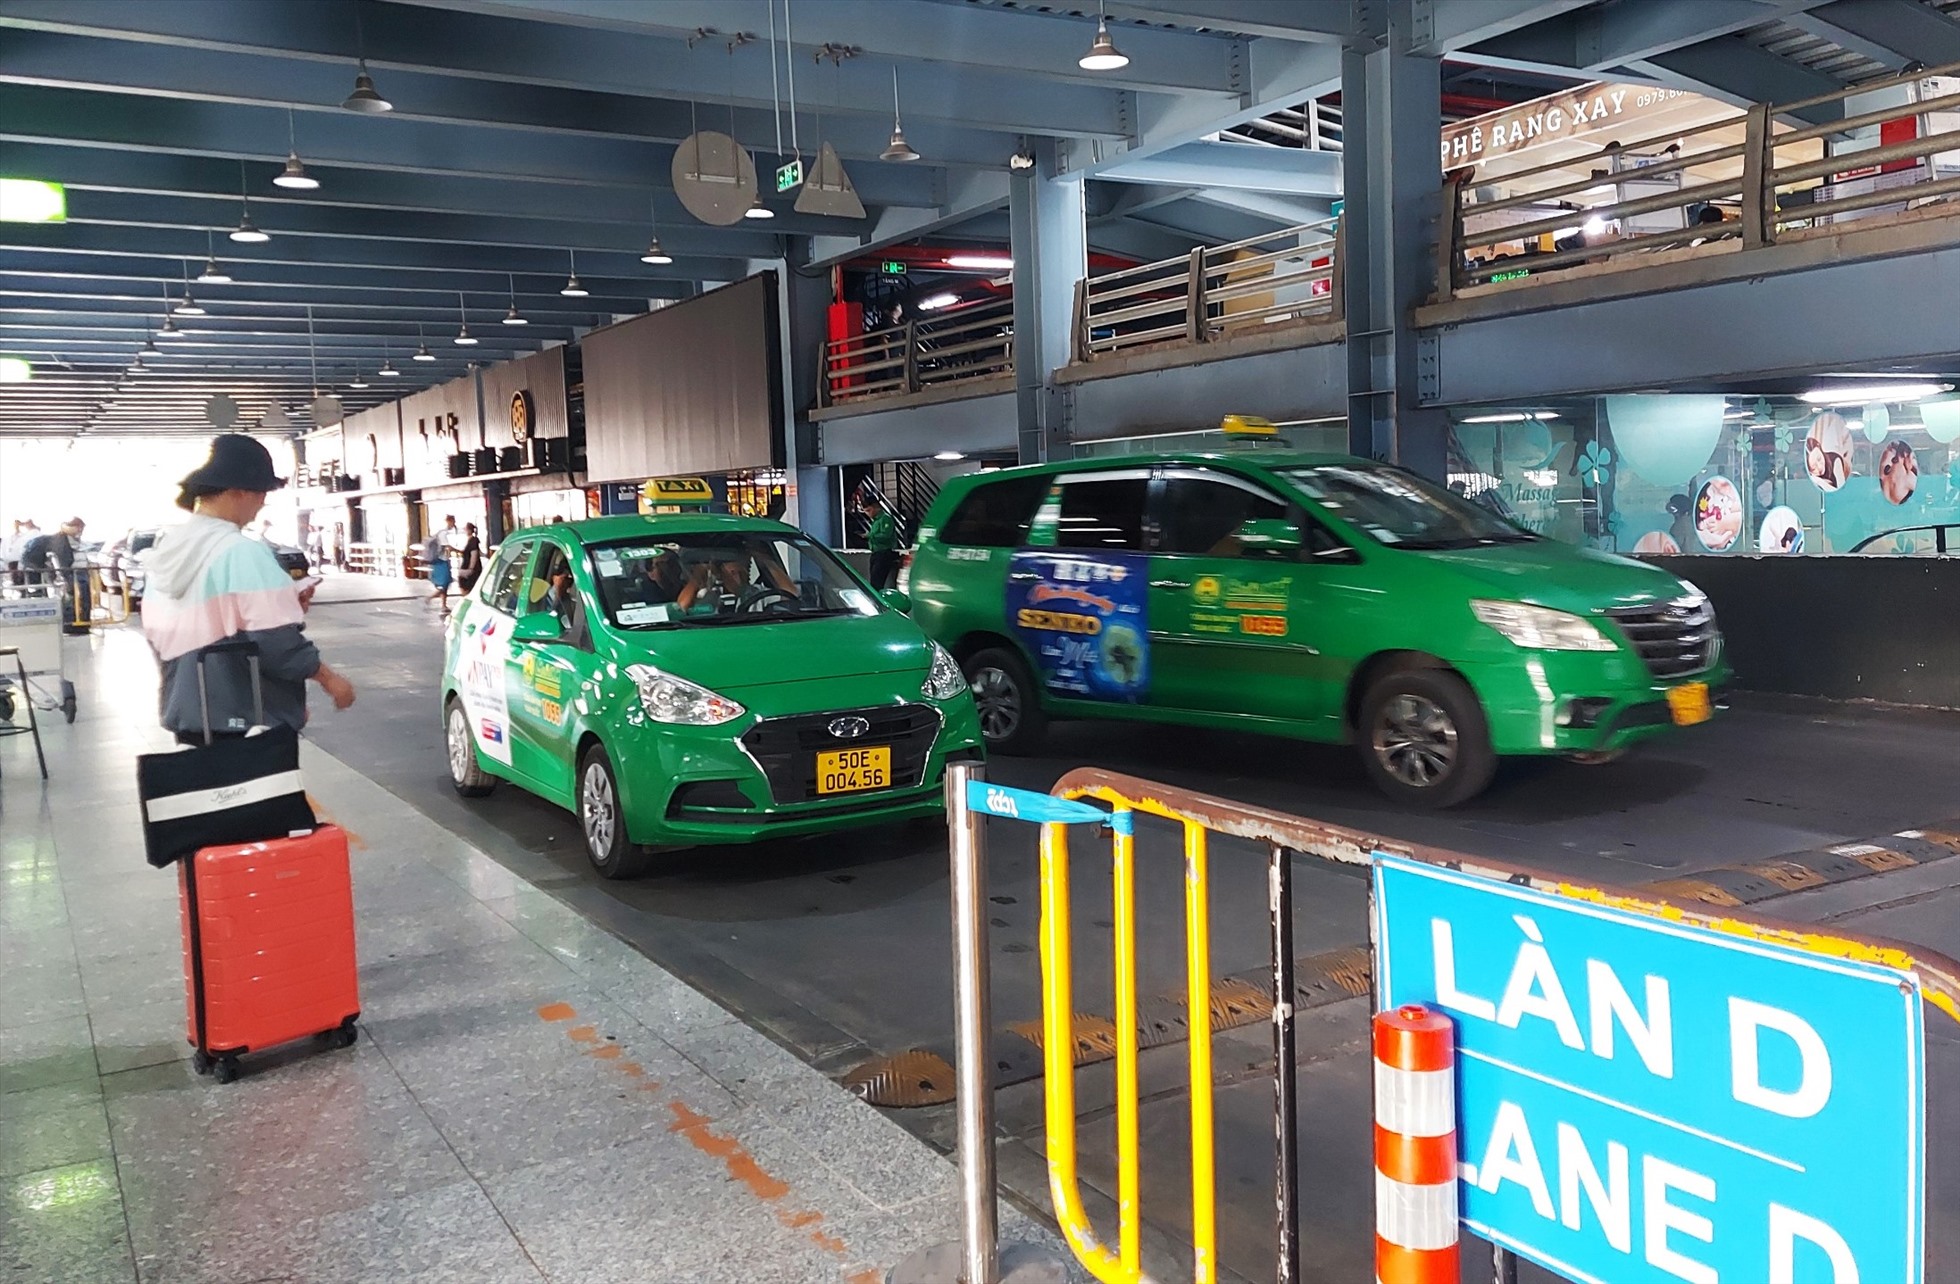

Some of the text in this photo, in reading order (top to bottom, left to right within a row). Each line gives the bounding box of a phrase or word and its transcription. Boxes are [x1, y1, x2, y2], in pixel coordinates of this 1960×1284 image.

[1441, 126, 1483, 162] PHÊ
[1492, 108, 1562, 147] RANG
[1572, 89, 1627, 125] XAY
[656, 481, 701, 490] TAXI
[628, 547, 657, 558] 1303
[838, 750, 870, 769] 50E
[826, 768, 883, 791] 004.56
[1431, 915, 1832, 1119] LÀN D
[1457, 1101, 1861, 1284] ANE D
